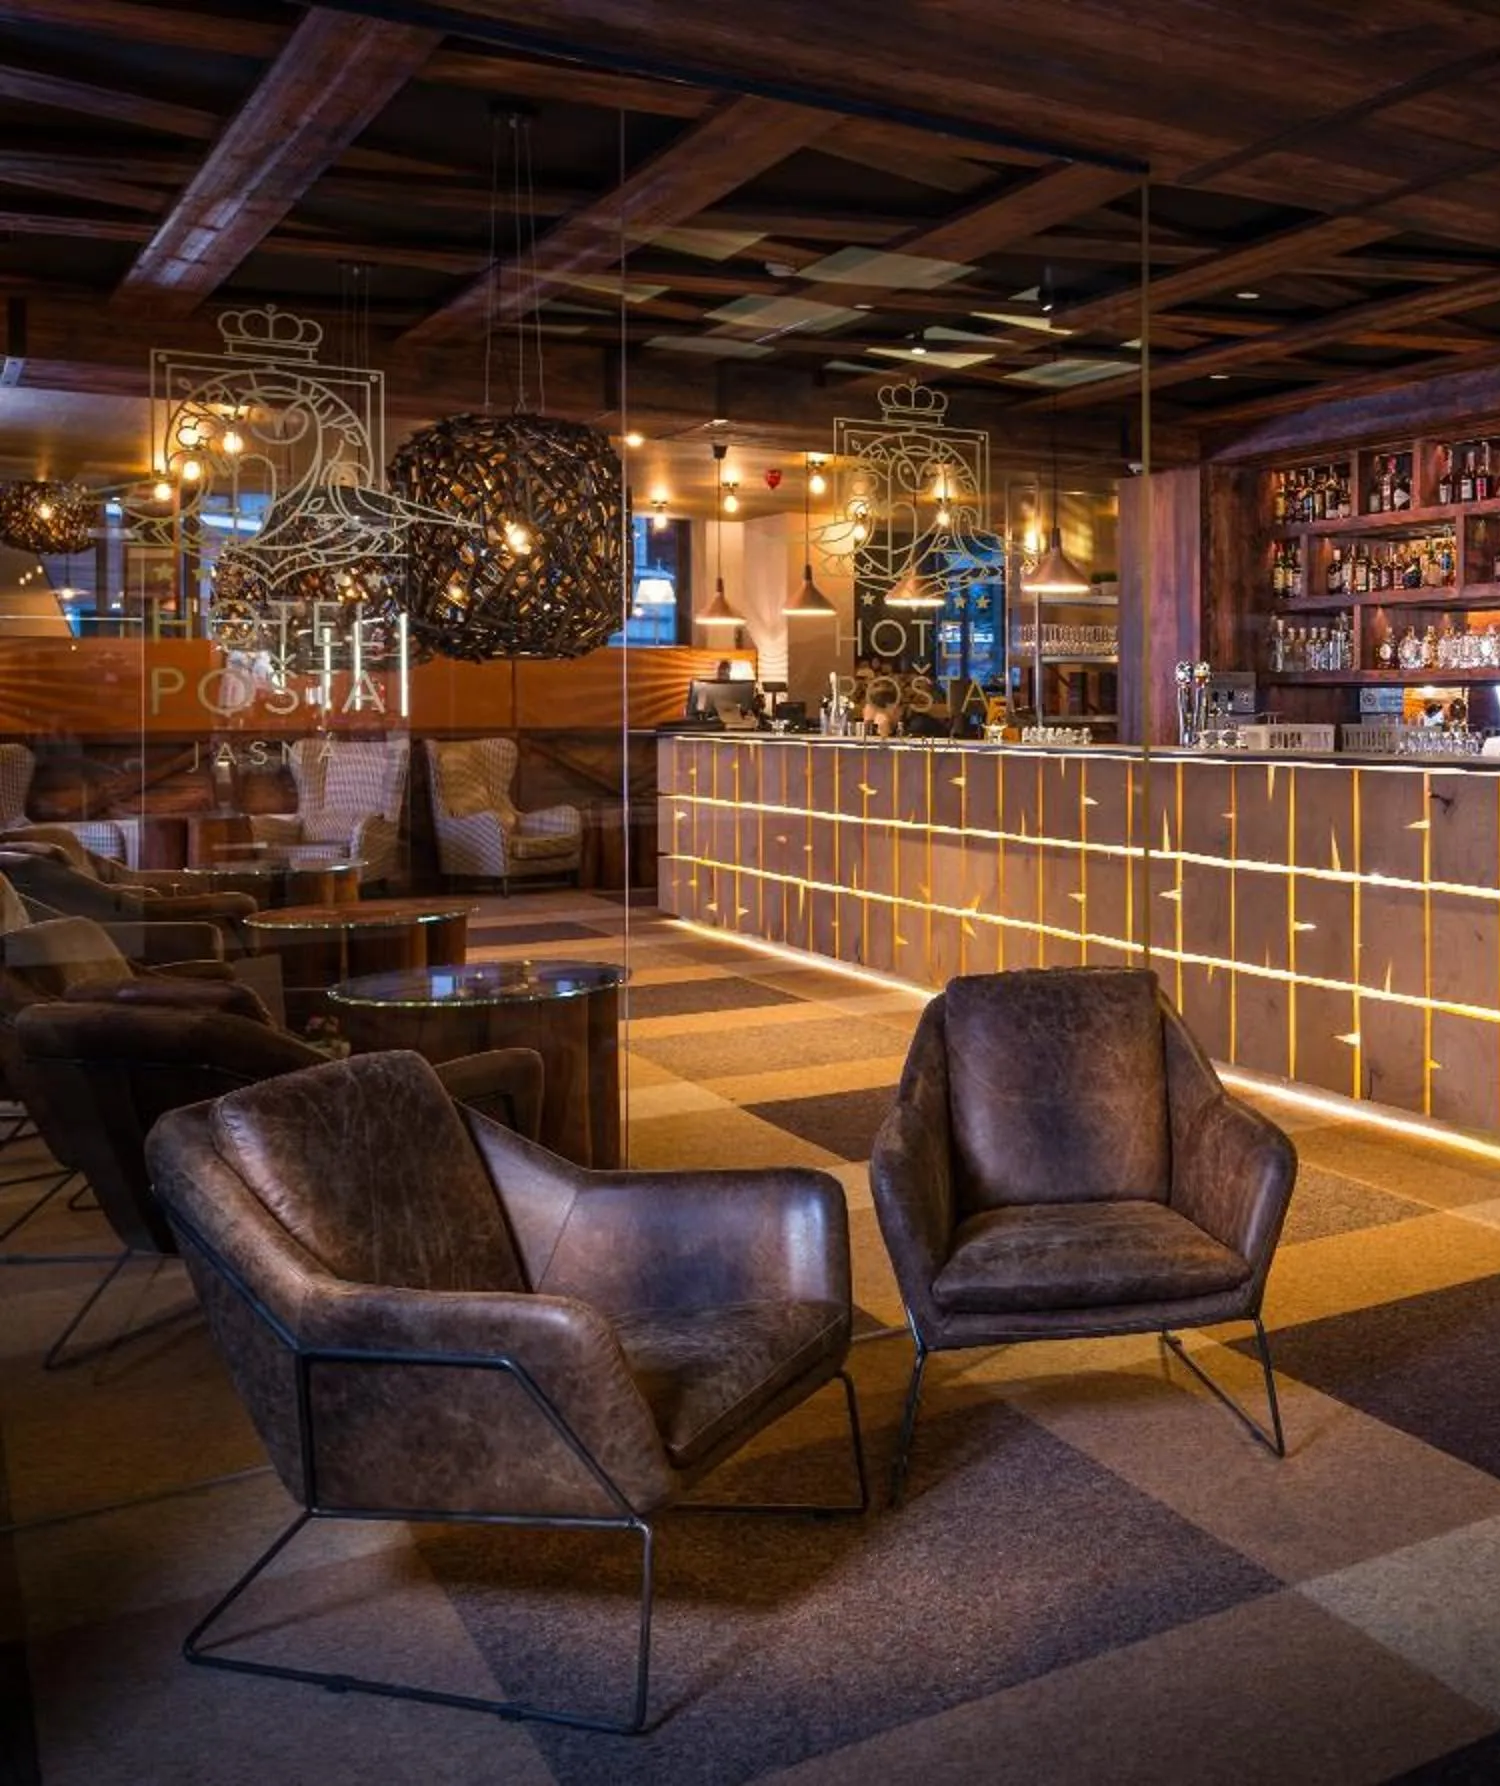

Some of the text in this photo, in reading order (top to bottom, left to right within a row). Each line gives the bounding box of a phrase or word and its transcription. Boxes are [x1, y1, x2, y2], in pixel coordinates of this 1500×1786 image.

[153, 599, 385, 646] HOTEL
[835, 619, 989, 657] HOTEL
[836, 663, 990, 713] POŠTA
